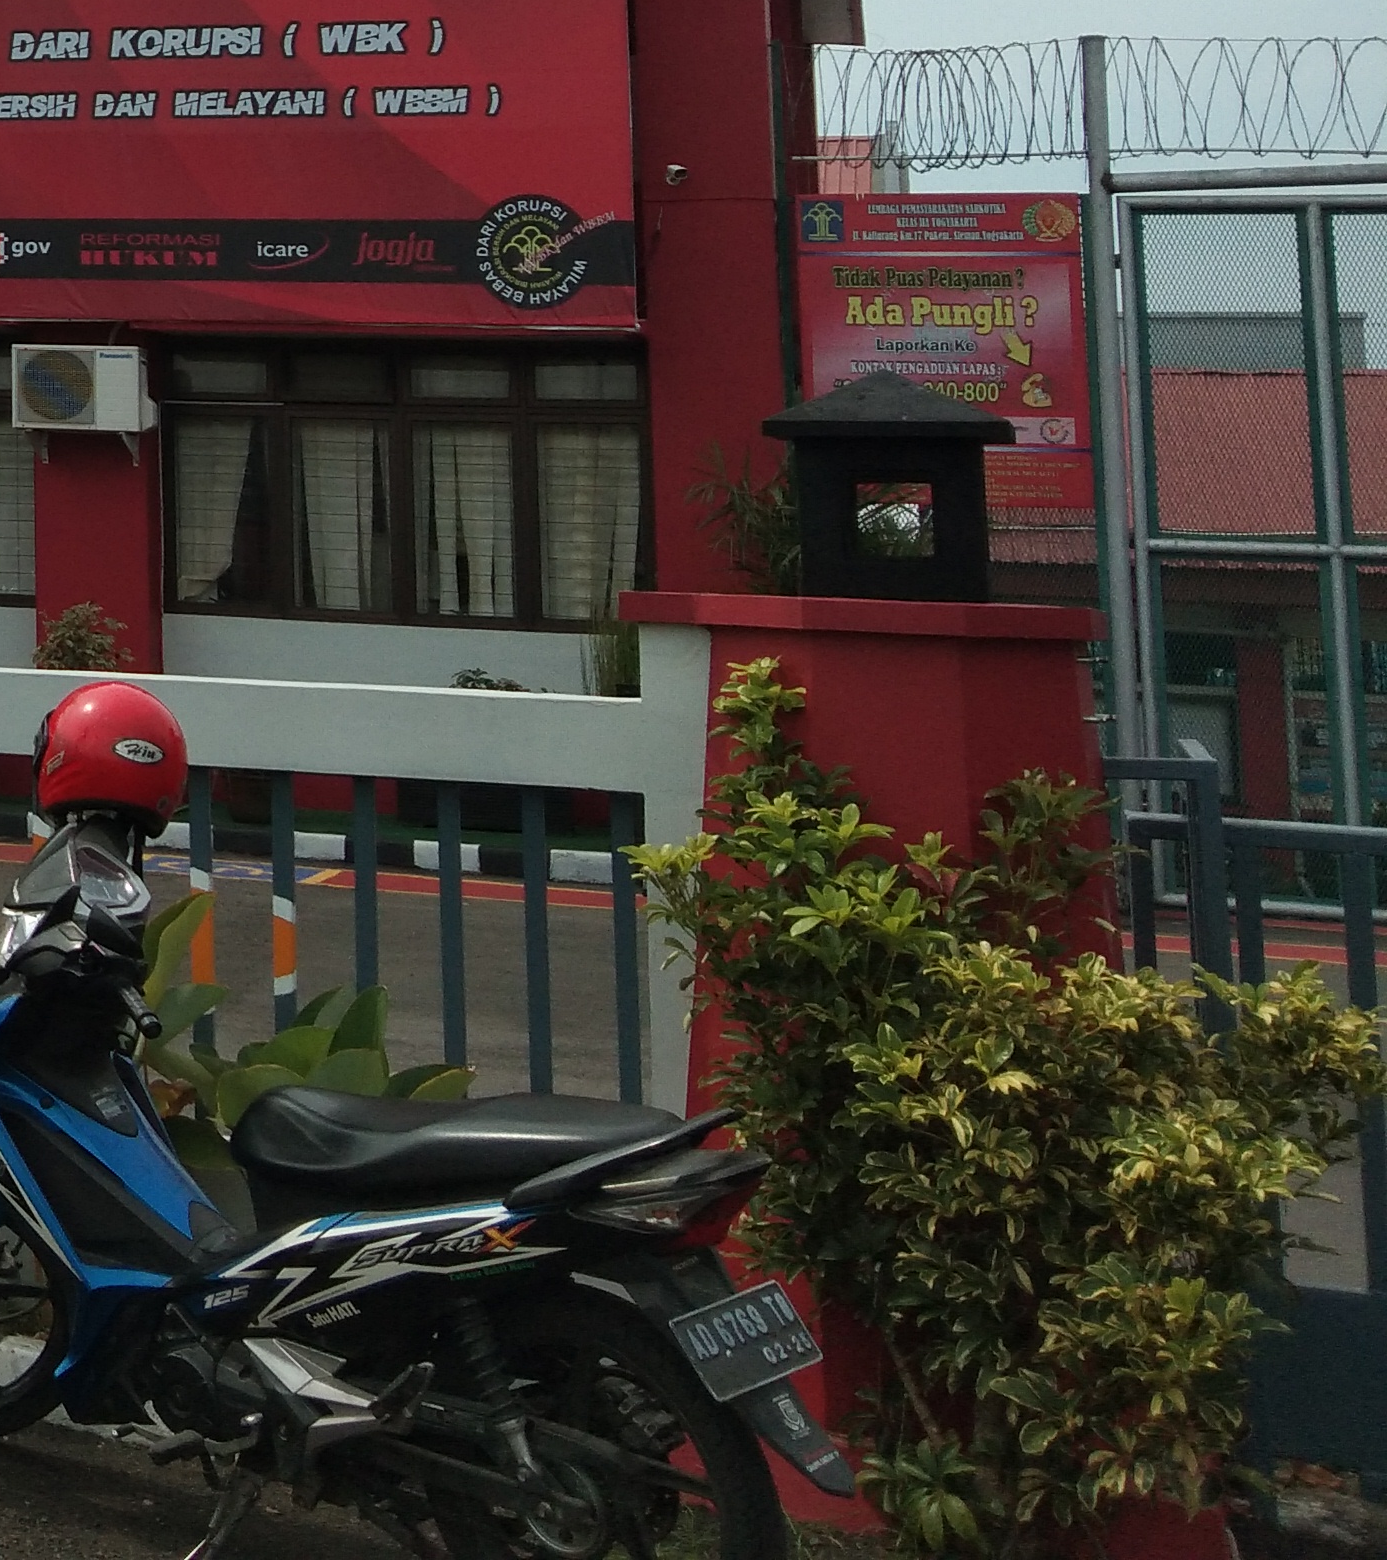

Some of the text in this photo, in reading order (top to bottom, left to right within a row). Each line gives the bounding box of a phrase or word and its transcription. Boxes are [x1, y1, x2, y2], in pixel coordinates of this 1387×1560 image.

[10, 30, 90, 60] DARI
[110, 26, 262, 59] KORUPSI
[320, 22, 407, 54] WBK
[93, 91, 157, 118] DAN
[173, 89, 325, 117] MELAYANI
[374, 87, 468, 115] WBBM
[11, 239, 51, 258] gov
[80, 233, 221, 247] REFORMASI
[256, 241, 309, 258] icare
[476, 199, 588, 305] WILAYAH BEBAS DARI KORUPSI
[80, 249, 220, 266] HUKUM
[832, 266, 1024, 291] Tidak Puas Pelayanan ?
[845, 294, 1039, 335] Ada Pungli ?
[876, 338, 976, 353] Laporkan Ke
[895, 361, 960, 375] PENGADUAN
[962, 363, 996, 375] LAPAS
[202, 1284, 251, 1310] 125
[686, 1323, 721, 1361] AD
[712, 1304, 769, 1348] 6769
